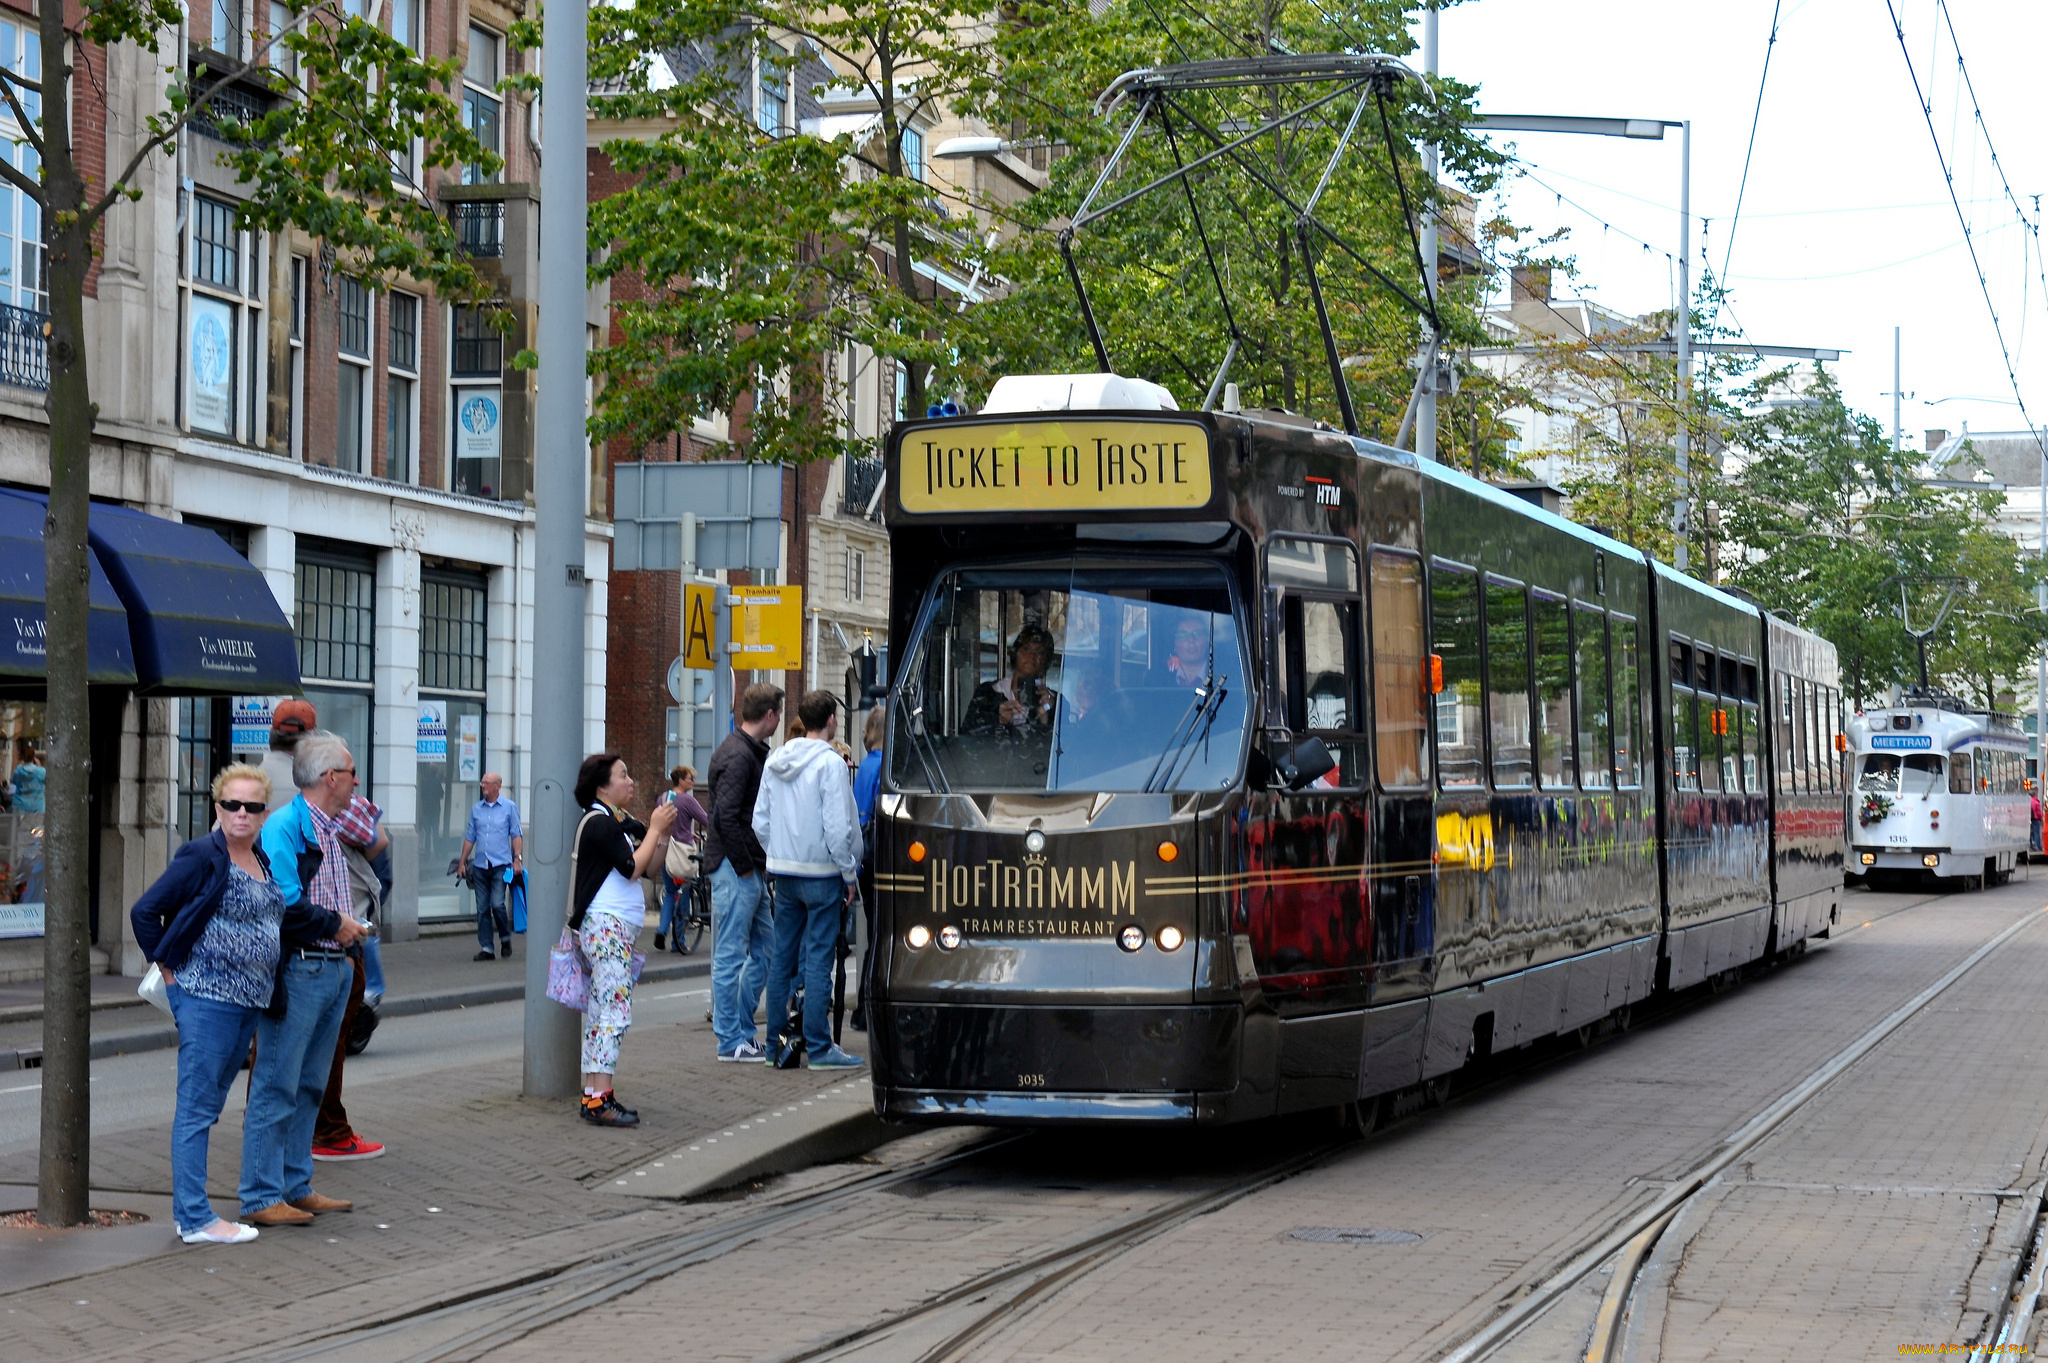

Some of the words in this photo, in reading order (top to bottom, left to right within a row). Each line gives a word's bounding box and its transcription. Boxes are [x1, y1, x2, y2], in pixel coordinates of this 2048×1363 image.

[1277, 485, 1298, 498] POWERED
[1298, 488, 1305, 498] BY
[1316, 484, 1341, 506] HTM
[745, 588, 781, 596] Tramhalte
[686, 593, 712, 660] A
[217, 638, 257, 659] WIELIK
[1873, 738, 1931, 748] MEETTRAM
[1889, 835, 1908, 844] 1315
[962, 918, 1116, 936] TRAMRESTAURANT
[1017, 1074, 1045, 1087] 3035
